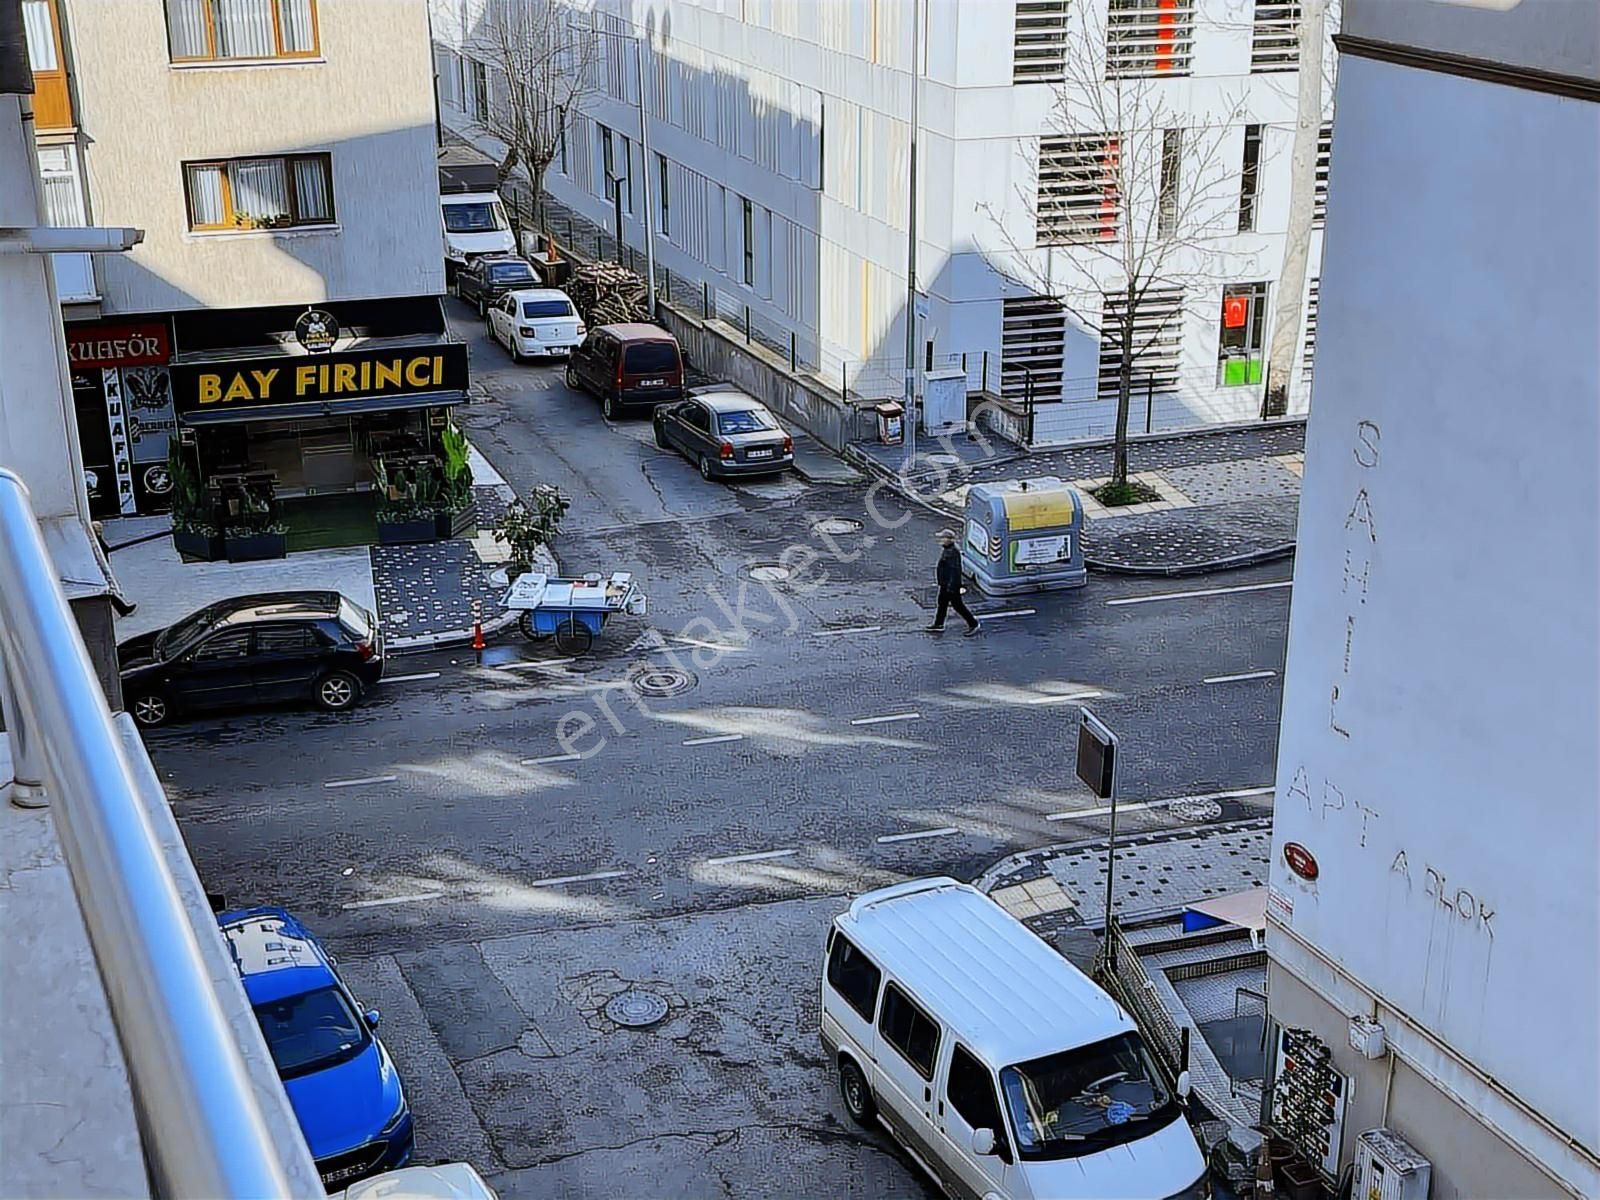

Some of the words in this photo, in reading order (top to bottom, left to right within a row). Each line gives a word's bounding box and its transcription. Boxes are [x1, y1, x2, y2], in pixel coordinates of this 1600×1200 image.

[199, 368, 280, 404] BAY
[296, 355, 443, 396] FIRINCI
[1287, 765, 1380, 848] APT
